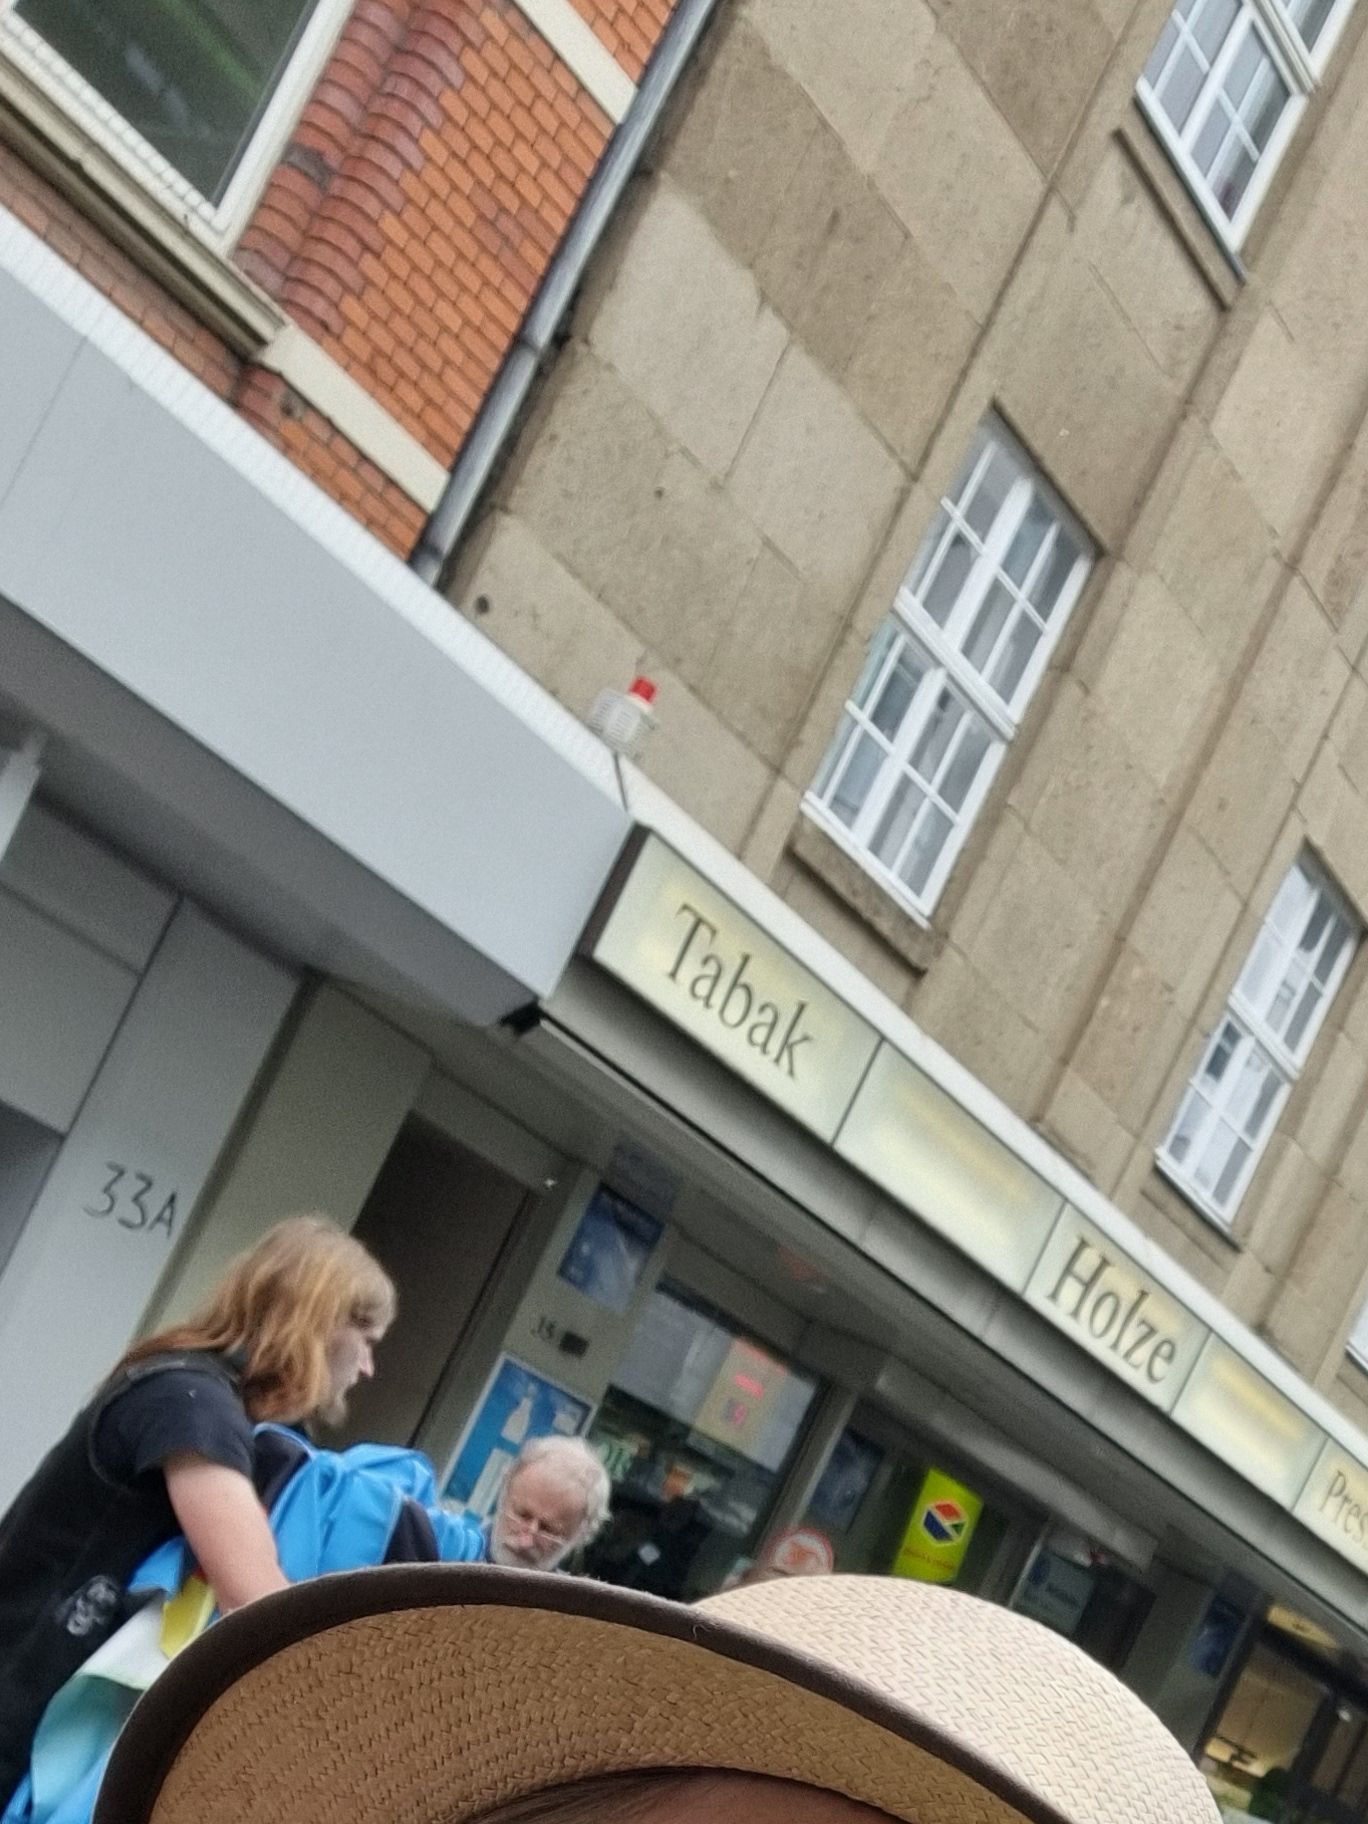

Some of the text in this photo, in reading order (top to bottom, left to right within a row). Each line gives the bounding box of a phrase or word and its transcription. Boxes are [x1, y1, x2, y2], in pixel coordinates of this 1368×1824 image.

[82, 1161, 176, 1238] 33A
[668, 903, 813, 1077] Tabak
[1047, 1235, 1176, 1384] Holze
